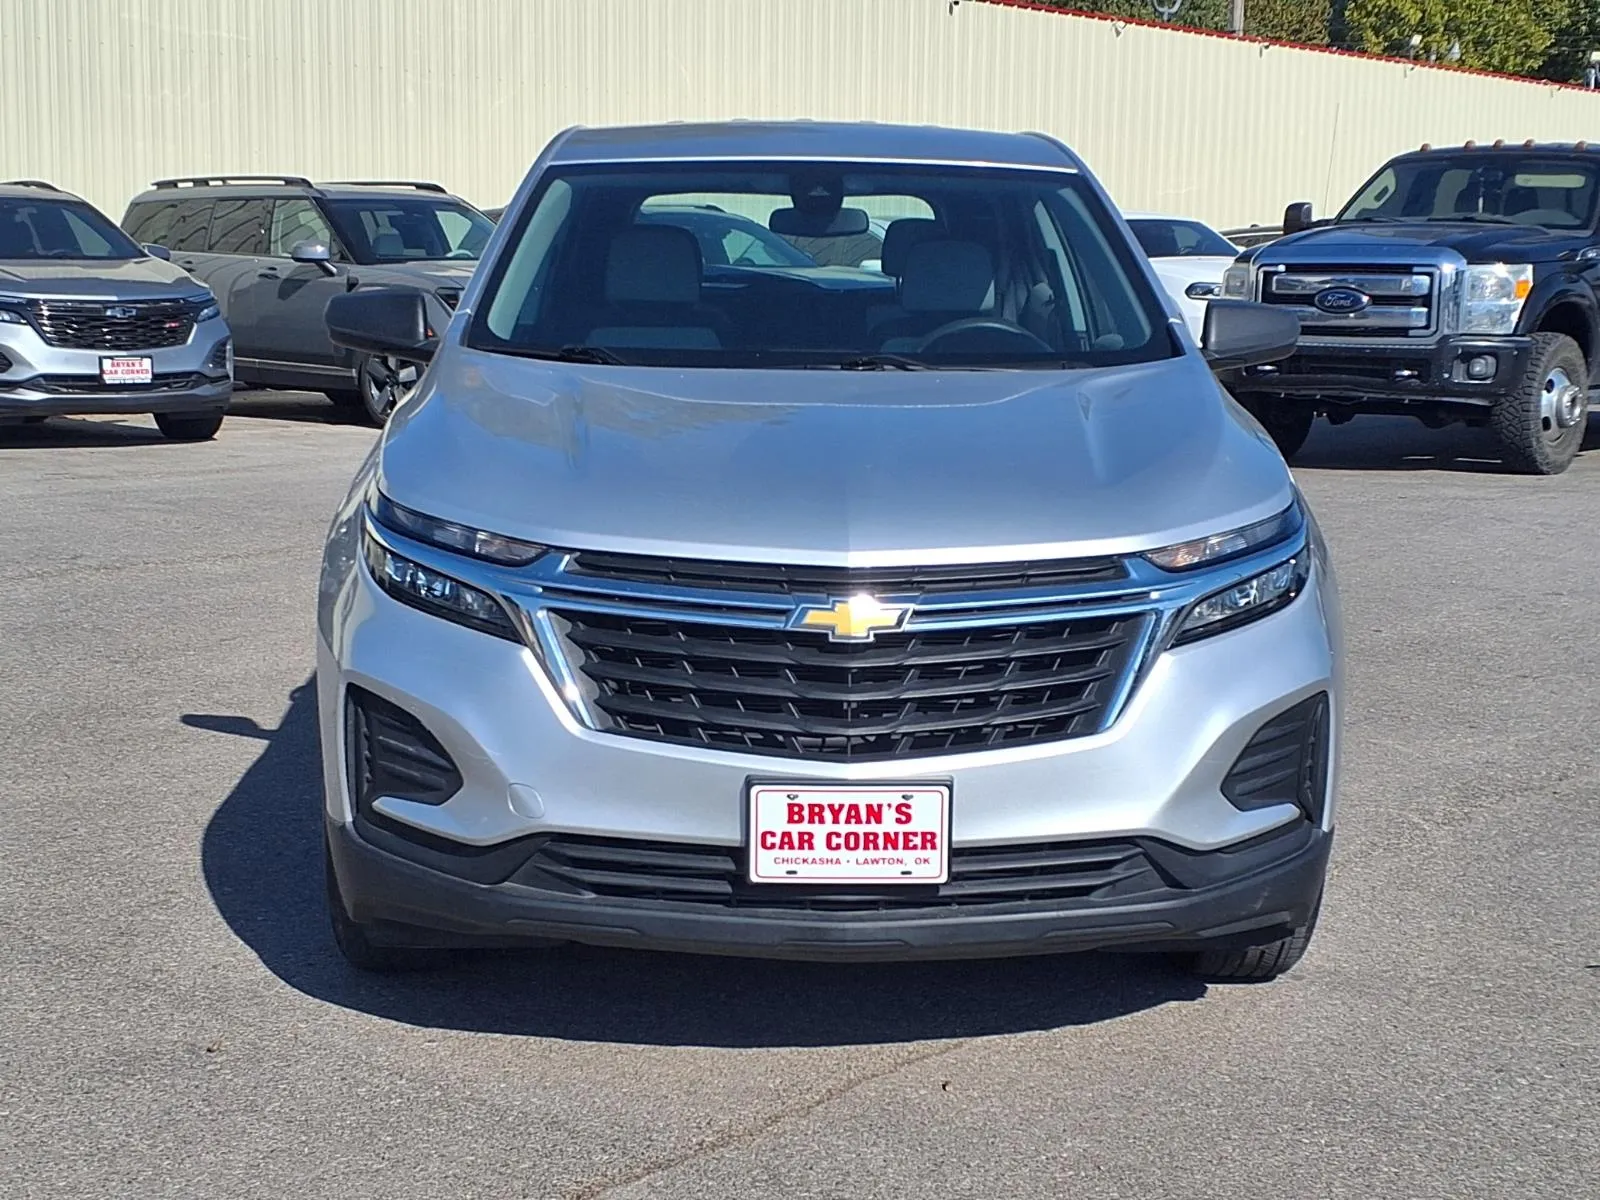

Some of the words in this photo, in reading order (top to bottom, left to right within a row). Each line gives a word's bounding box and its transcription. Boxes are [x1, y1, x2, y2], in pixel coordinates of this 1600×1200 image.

[1324, 293, 1354, 307] Ford
[786, 802, 913, 825] BRYAN'S
[760, 830, 815, 851] CAR
[825, 831, 938, 851] CORNER
[773, 856, 842, 865] CHICKASHA
[855, 857, 909, 867] LAWTON,
[914, 857, 931, 865] OK
